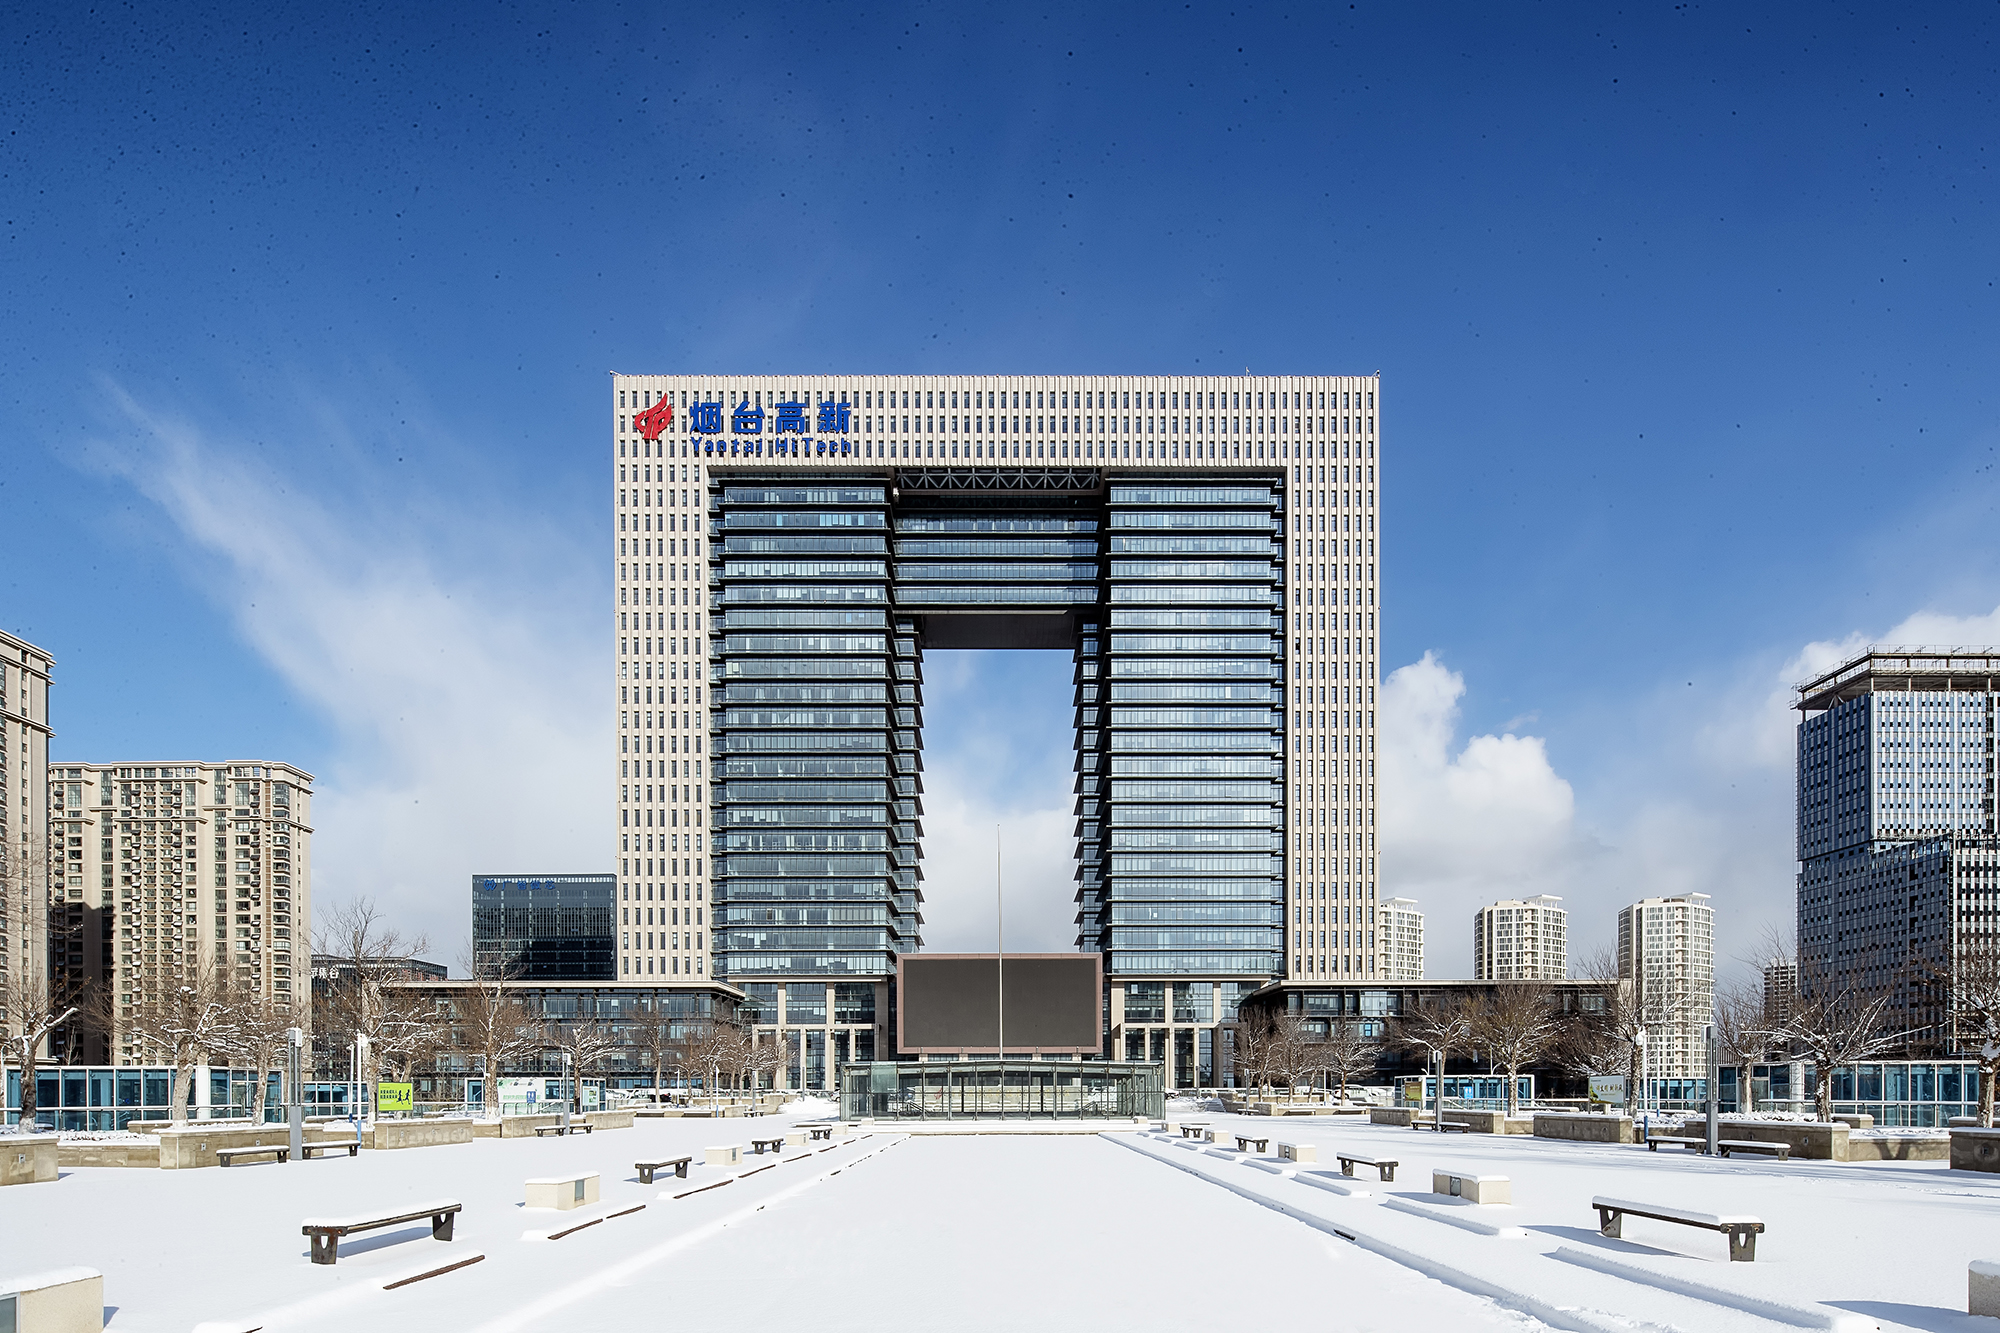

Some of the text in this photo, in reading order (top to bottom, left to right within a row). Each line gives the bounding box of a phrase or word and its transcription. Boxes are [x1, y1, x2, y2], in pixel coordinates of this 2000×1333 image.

[689, 401, 851, 434] 烟台高新
[690, 436, 851, 453] Yantai HiTech
